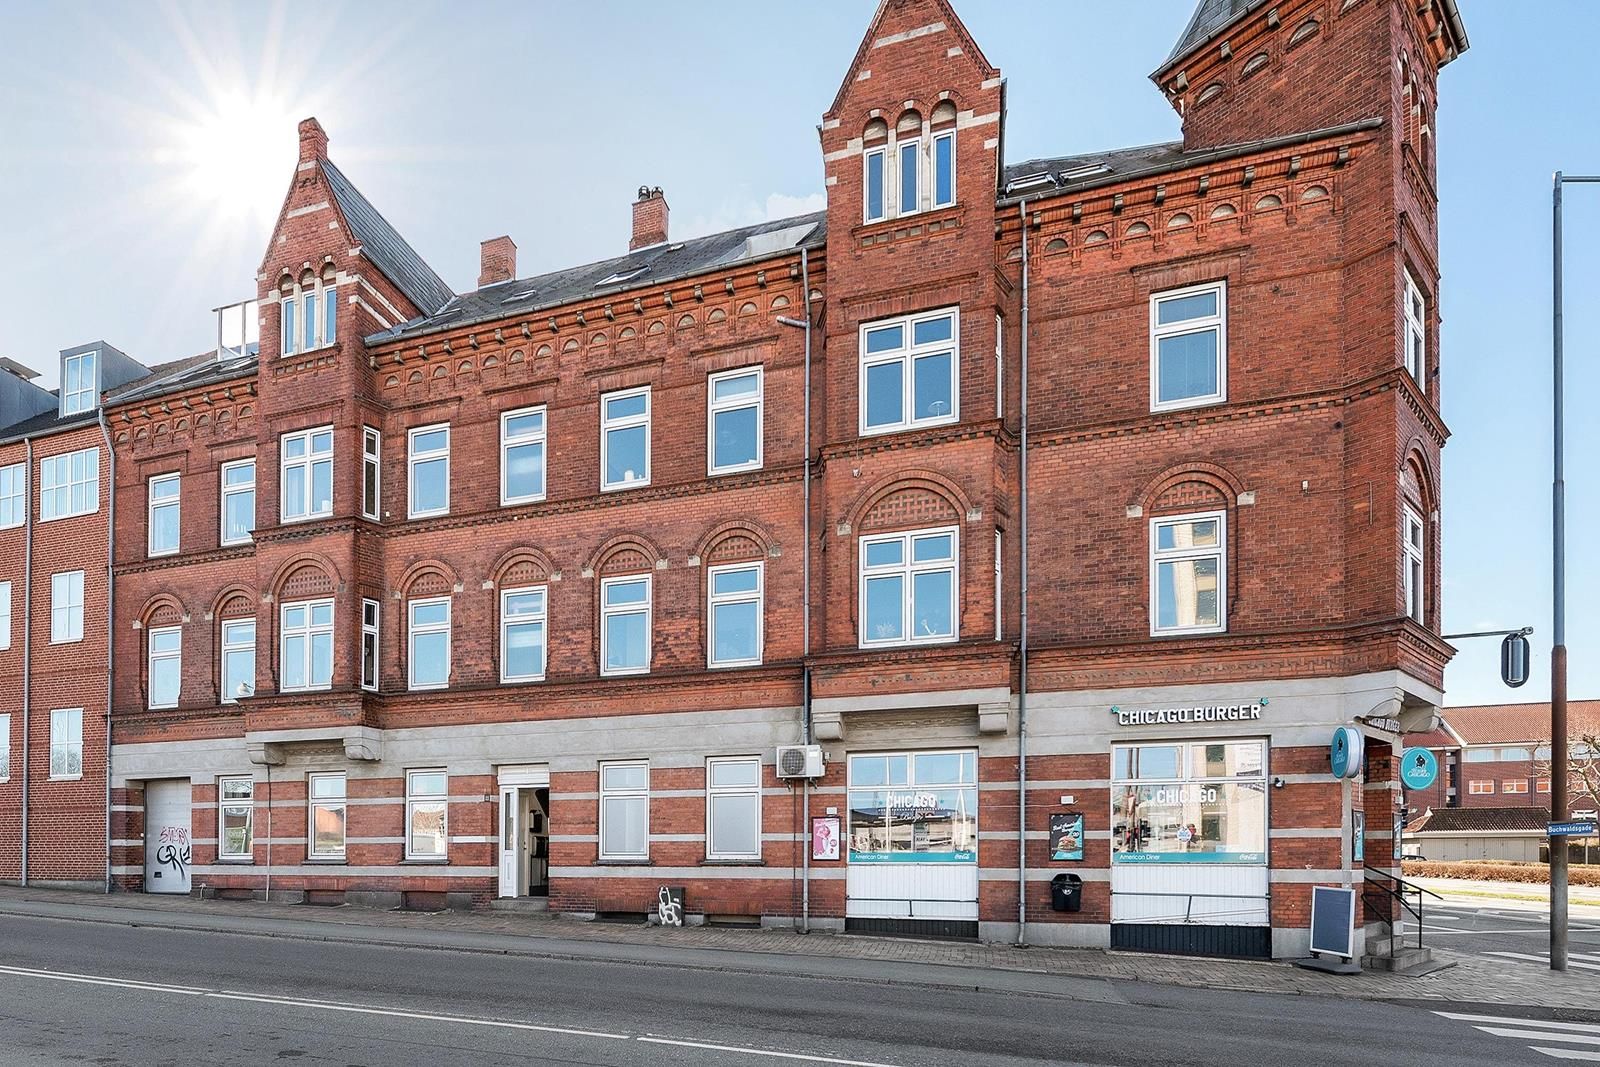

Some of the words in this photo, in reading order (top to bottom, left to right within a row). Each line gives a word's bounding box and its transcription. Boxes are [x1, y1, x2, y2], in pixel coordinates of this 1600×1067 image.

[1118, 708, 1188, 726] CHICAGO
[1193, 704, 1261, 722] BURGER
[886, 794, 936, 808] CHICAGO
[1156, 788, 1217, 804] CHICGO
[1548, 824, 1592, 834] Buchwaldsgade
